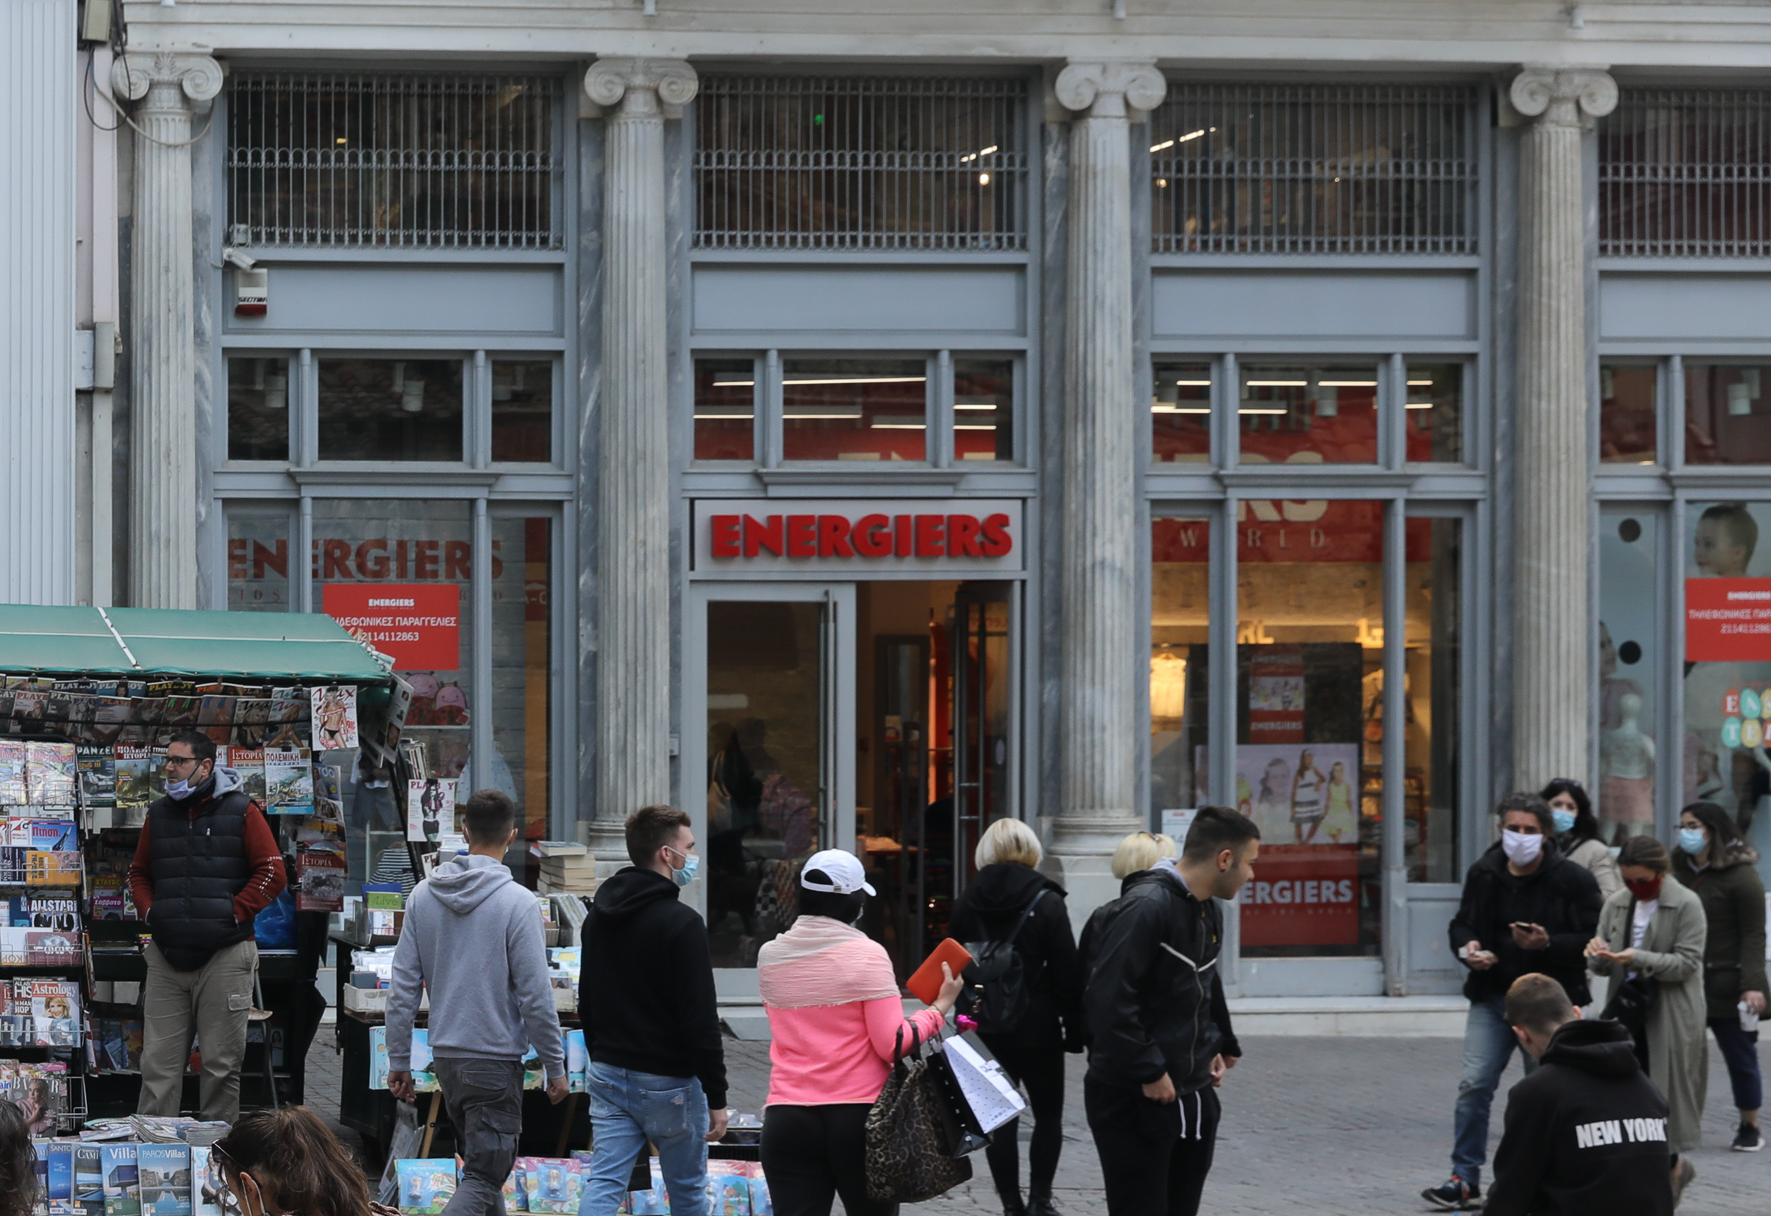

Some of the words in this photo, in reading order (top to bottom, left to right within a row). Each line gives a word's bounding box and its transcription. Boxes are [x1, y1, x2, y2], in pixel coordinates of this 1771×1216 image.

[710, 513, 1014, 558] ENERGIERS
[228, 539, 504, 579] ENRGIER
[368, 598, 415, 607] ENERGIERS
[332, 617, 394, 627] ΛΕΦΩΝΙΚΕΣ
[395, 617, 456, 627] ΠΑΡΑΓΓΕΛΙΕΣ
[361, 631, 420, 641] 2114112863
[98, 681, 144, 690] PLAOY
[77, 746, 115, 755] PANZE
[266, 752, 300, 762] ΠΟΛΕΜΙΚΗ
[1240, 879, 1353, 904] ERGIERS
[33, 983, 77, 998] Astrology
[1576, 1119, 1623, 1149] NEW
[1623, 1117, 1667, 1143] YORK
